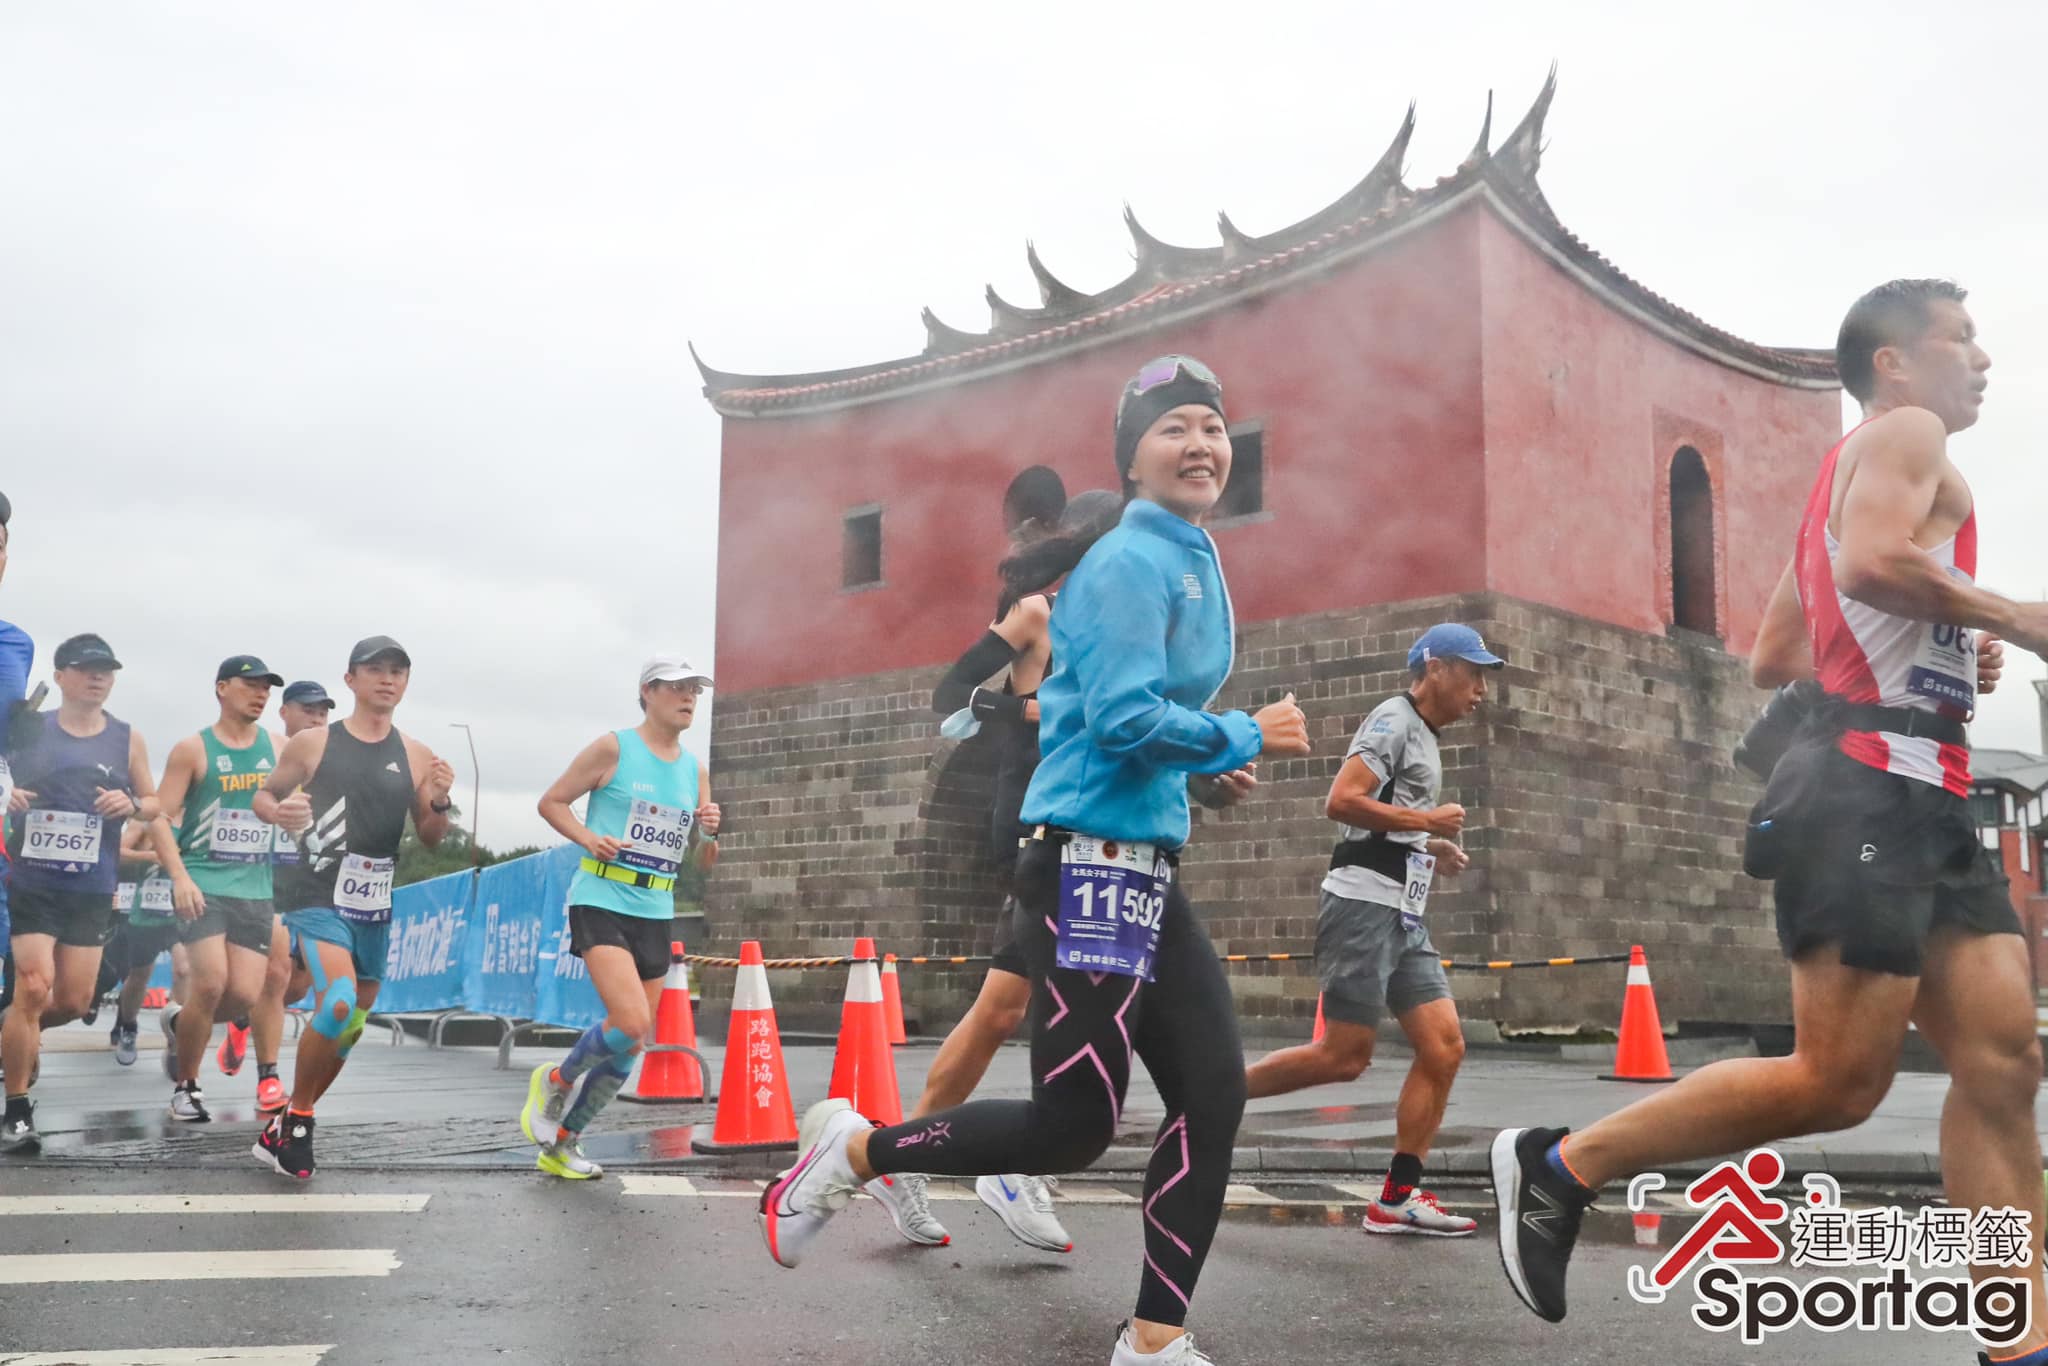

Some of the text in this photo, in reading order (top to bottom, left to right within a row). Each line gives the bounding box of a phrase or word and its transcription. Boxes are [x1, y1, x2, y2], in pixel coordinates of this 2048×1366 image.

[30, 831, 95, 850] 07567
[216, 827, 269, 843] 08507
[630, 823, 684, 850] 08496
[343, 878, 388, 898] 04711
[1073, 882, 1164, 931] 11592
[751, 1017, 773, 1108] 路跑協會
